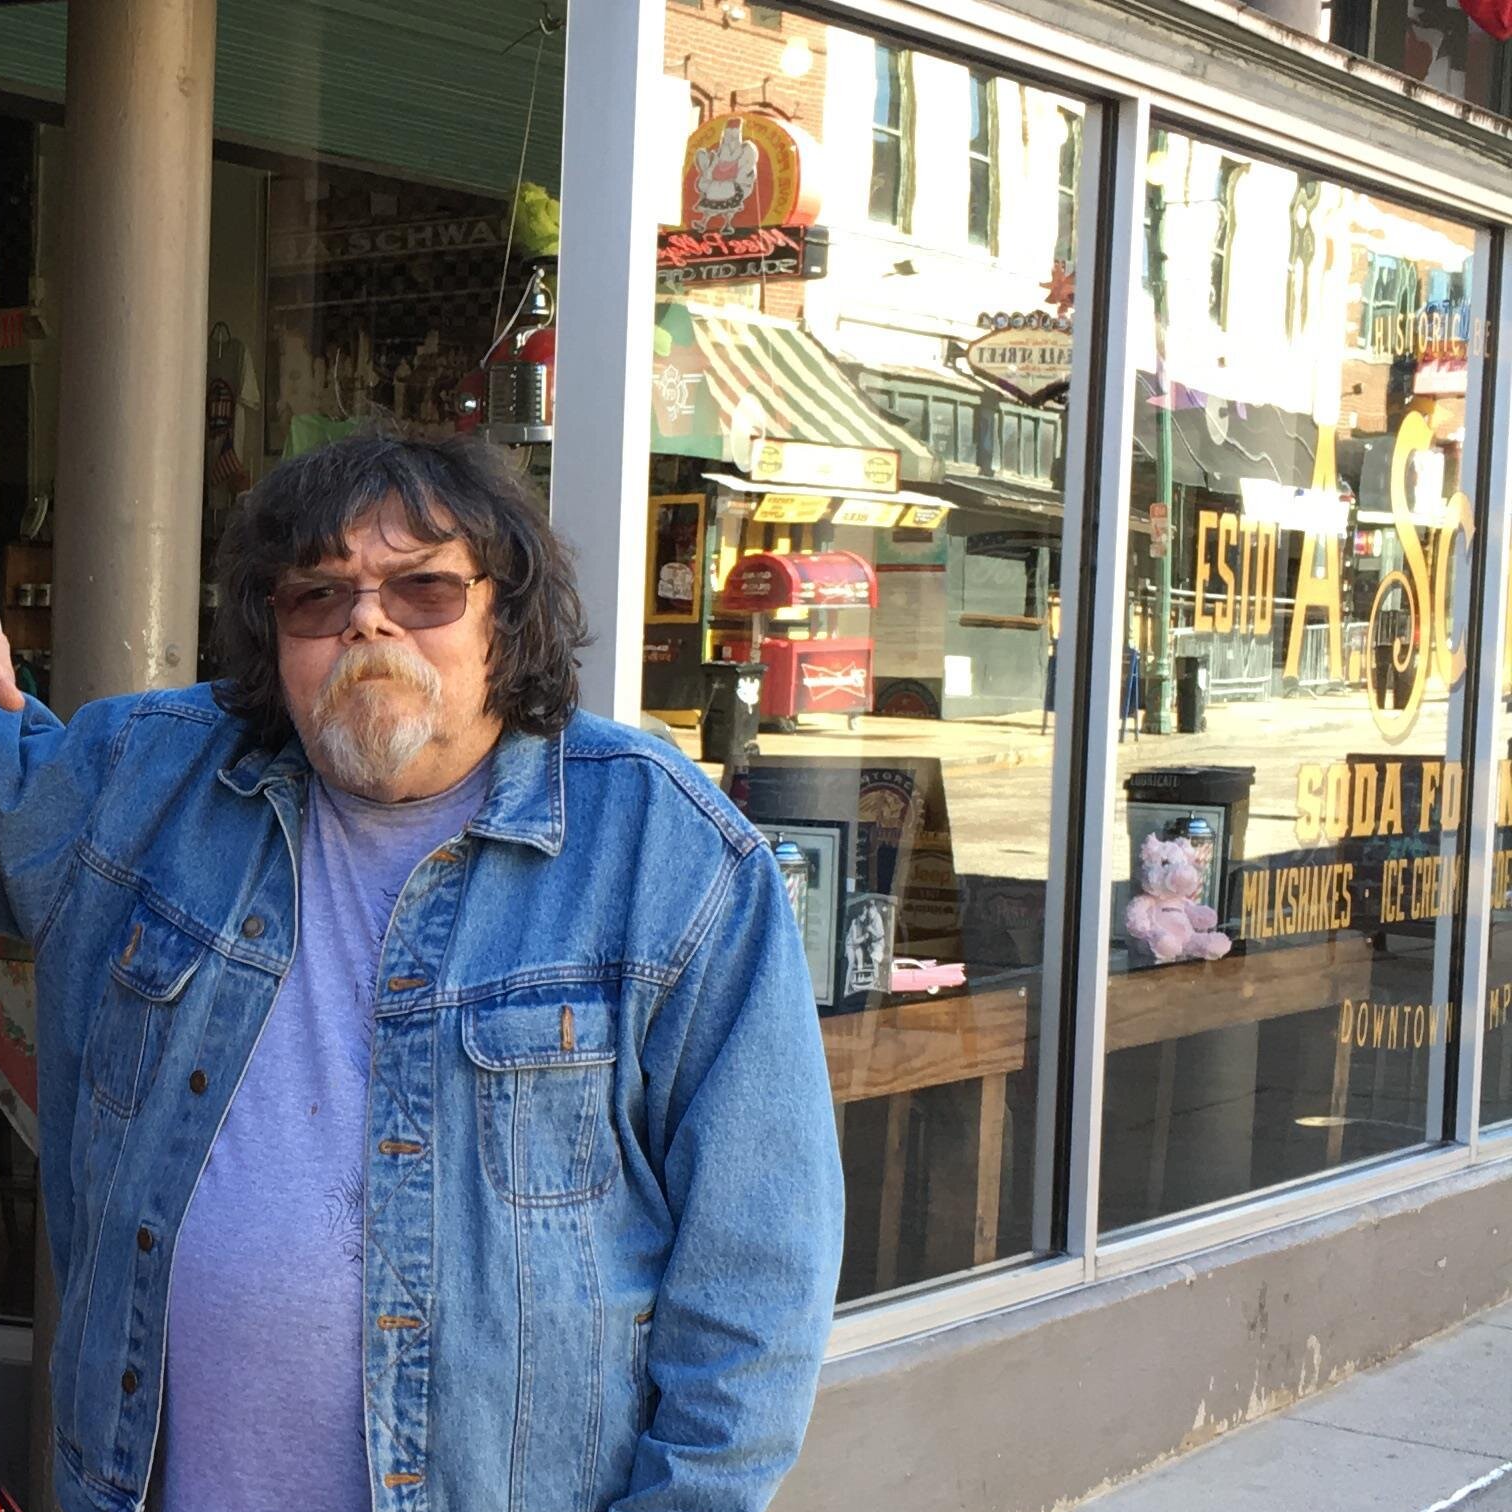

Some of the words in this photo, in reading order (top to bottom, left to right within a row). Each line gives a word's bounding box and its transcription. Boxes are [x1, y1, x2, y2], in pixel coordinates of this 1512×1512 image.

[348, 219, 510, 253] SCHWA
[1375, 312, 1461, 357] HISTORIC
[1194, 510, 1276, 635] ESTD
[1295, 763, 1403, 841] SODA
[1240, 864, 1353, 939] MILKSHAKES
[1380, 859, 1408, 924] ICE
[1341, 999, 1453, 1049] DOWNTOWN
